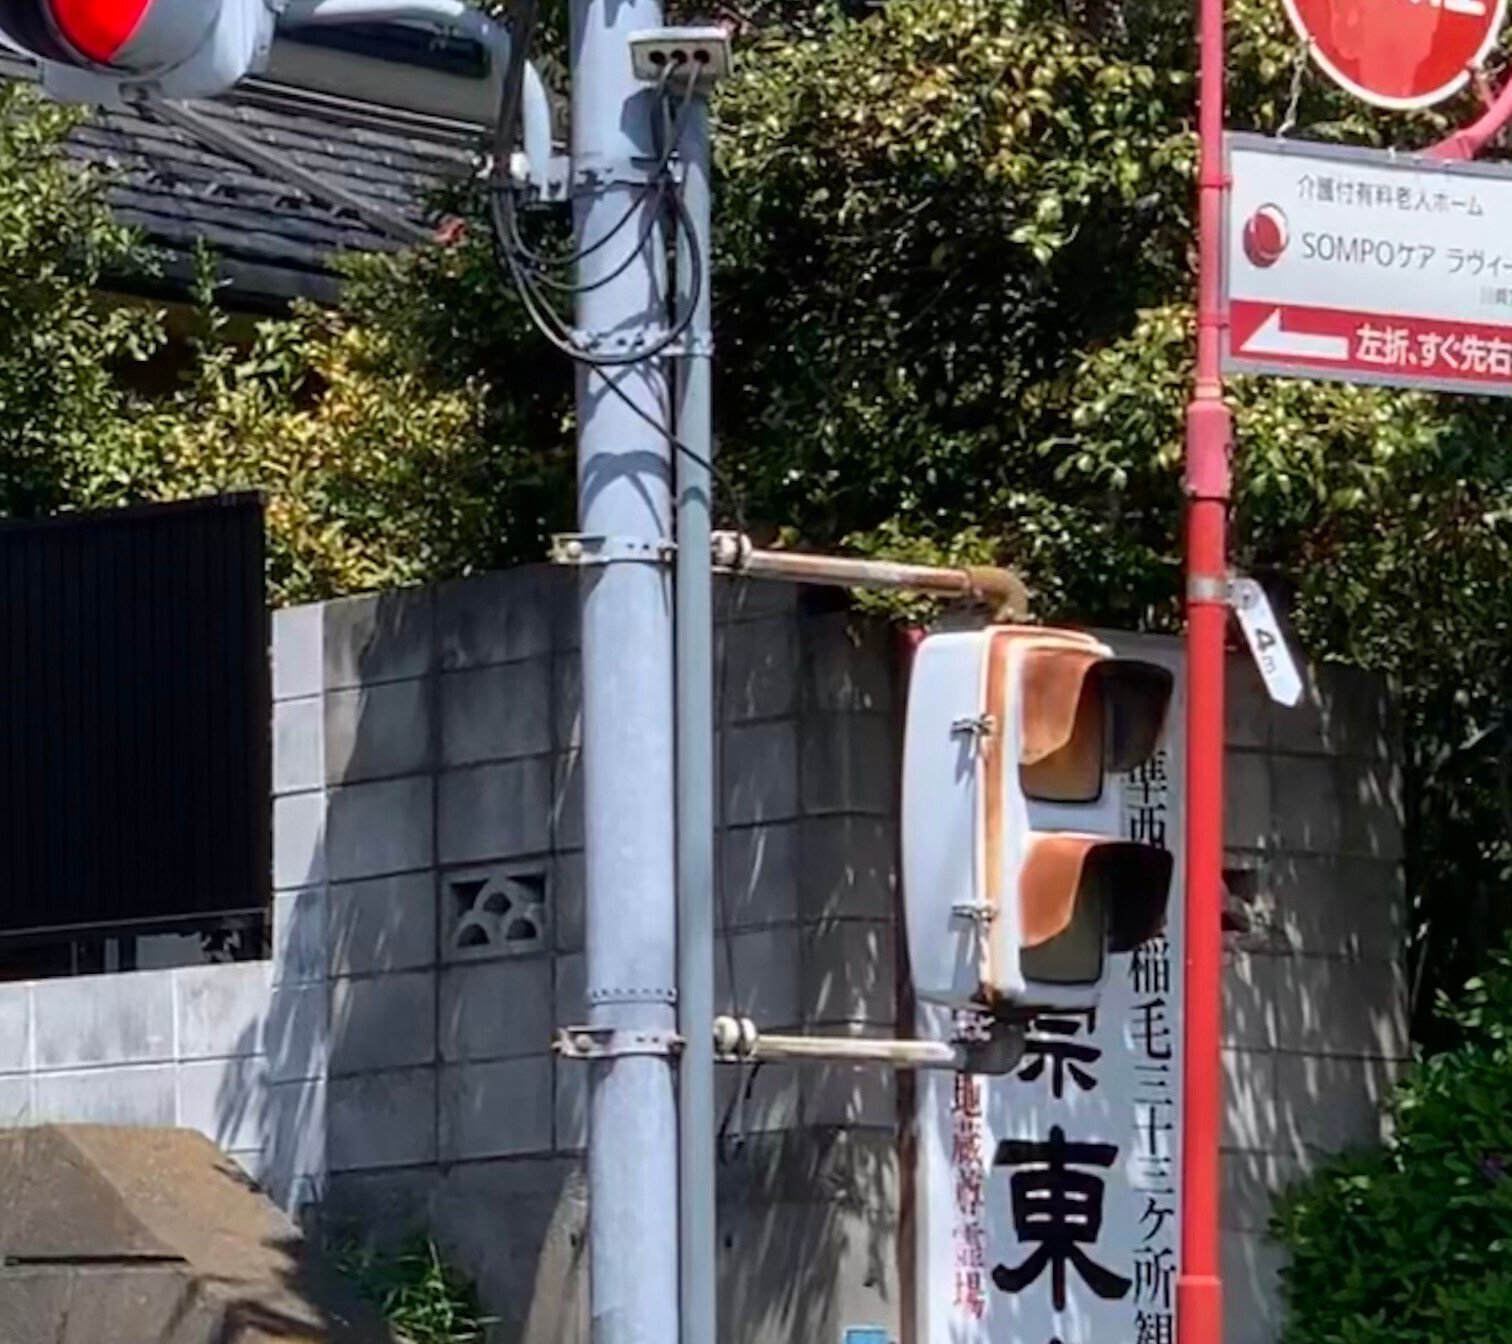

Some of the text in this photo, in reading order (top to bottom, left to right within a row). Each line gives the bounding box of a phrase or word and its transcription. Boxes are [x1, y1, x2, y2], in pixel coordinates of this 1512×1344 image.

[1297, 173, 1485, 217] 介護付有料老人ホーム
[1301, 231, 1436, 270] SOMPOケア
